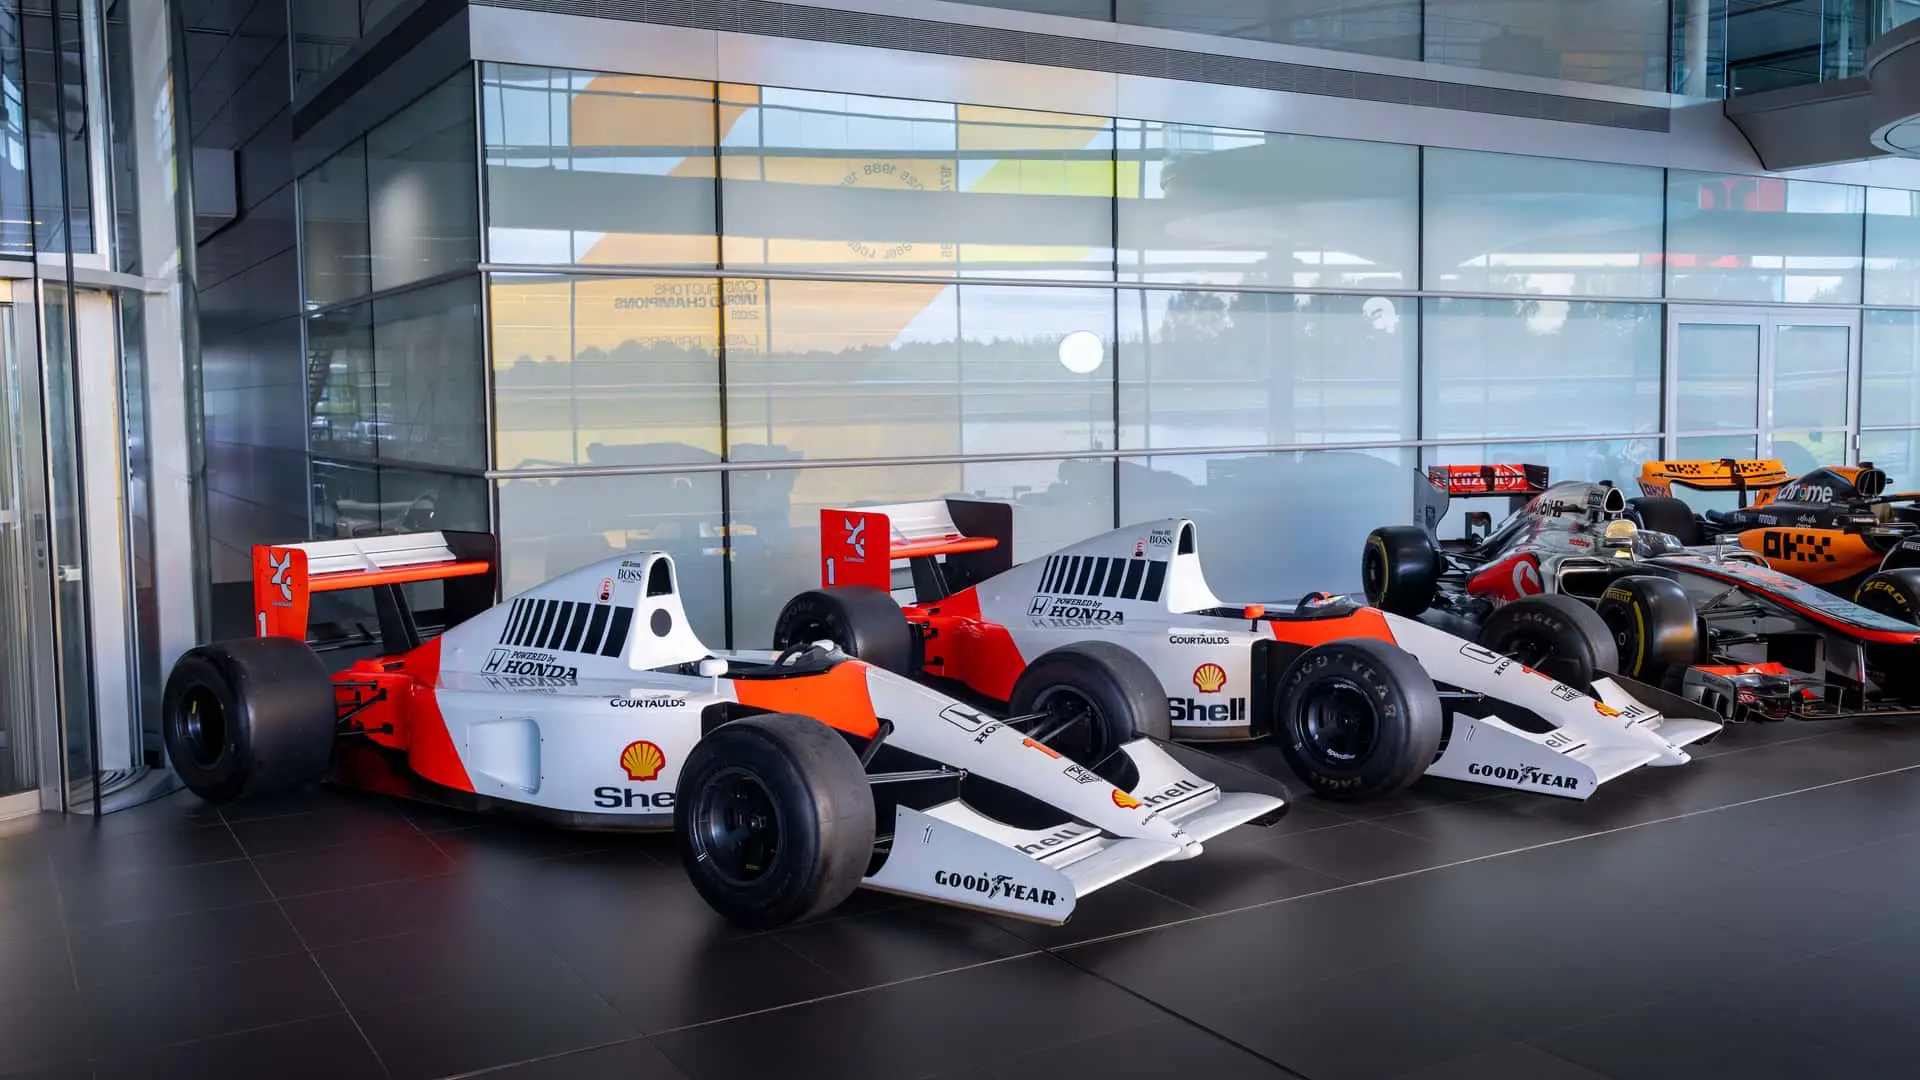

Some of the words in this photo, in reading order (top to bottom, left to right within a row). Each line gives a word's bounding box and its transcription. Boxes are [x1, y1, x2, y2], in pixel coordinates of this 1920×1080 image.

[1149, 535, 1173, 545] BOSS
[617, 568, 642, 582] BOSS
[1055, 598, 1092, 607] POWERED
[1048, 605, 1124, 621] HONDA
[1169, 635, 1230, 645] COURTAULDS
[511, 650, 548, 662] POWERED
[502, 660, 578, 680] HONDA
[610, 698, 686, 708] COURTAULDS
[1168, 697, 1245, 721] Shell
[594, 786, 676, 808] She
[1143, 780, 1199, 808] hell
[1014, 829, 1081, 856] hell
